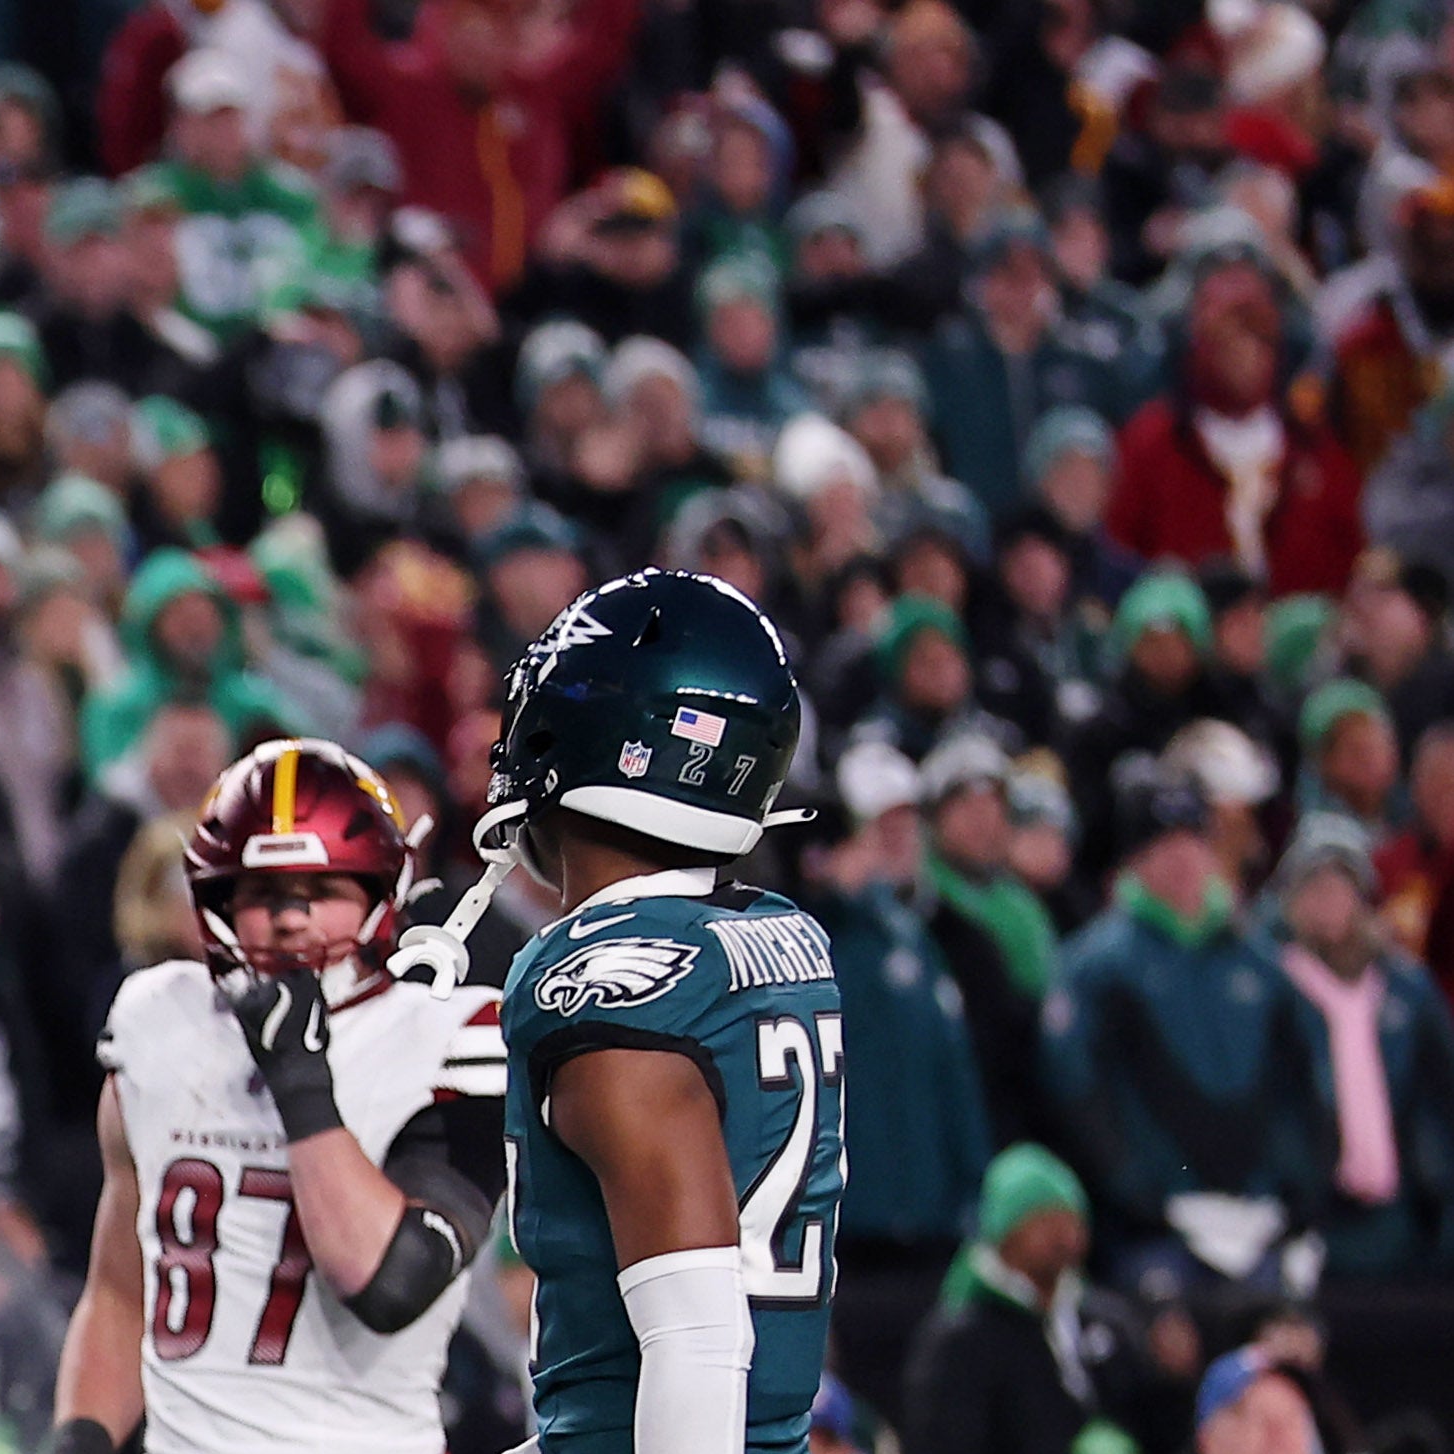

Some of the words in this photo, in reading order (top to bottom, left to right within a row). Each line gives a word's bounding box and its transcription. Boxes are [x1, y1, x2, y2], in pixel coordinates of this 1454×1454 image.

[678, 741, 757, 796] 27
[703, 914, 835, 992] MITCHEL
[154, 1156, 314, 1366] 87
